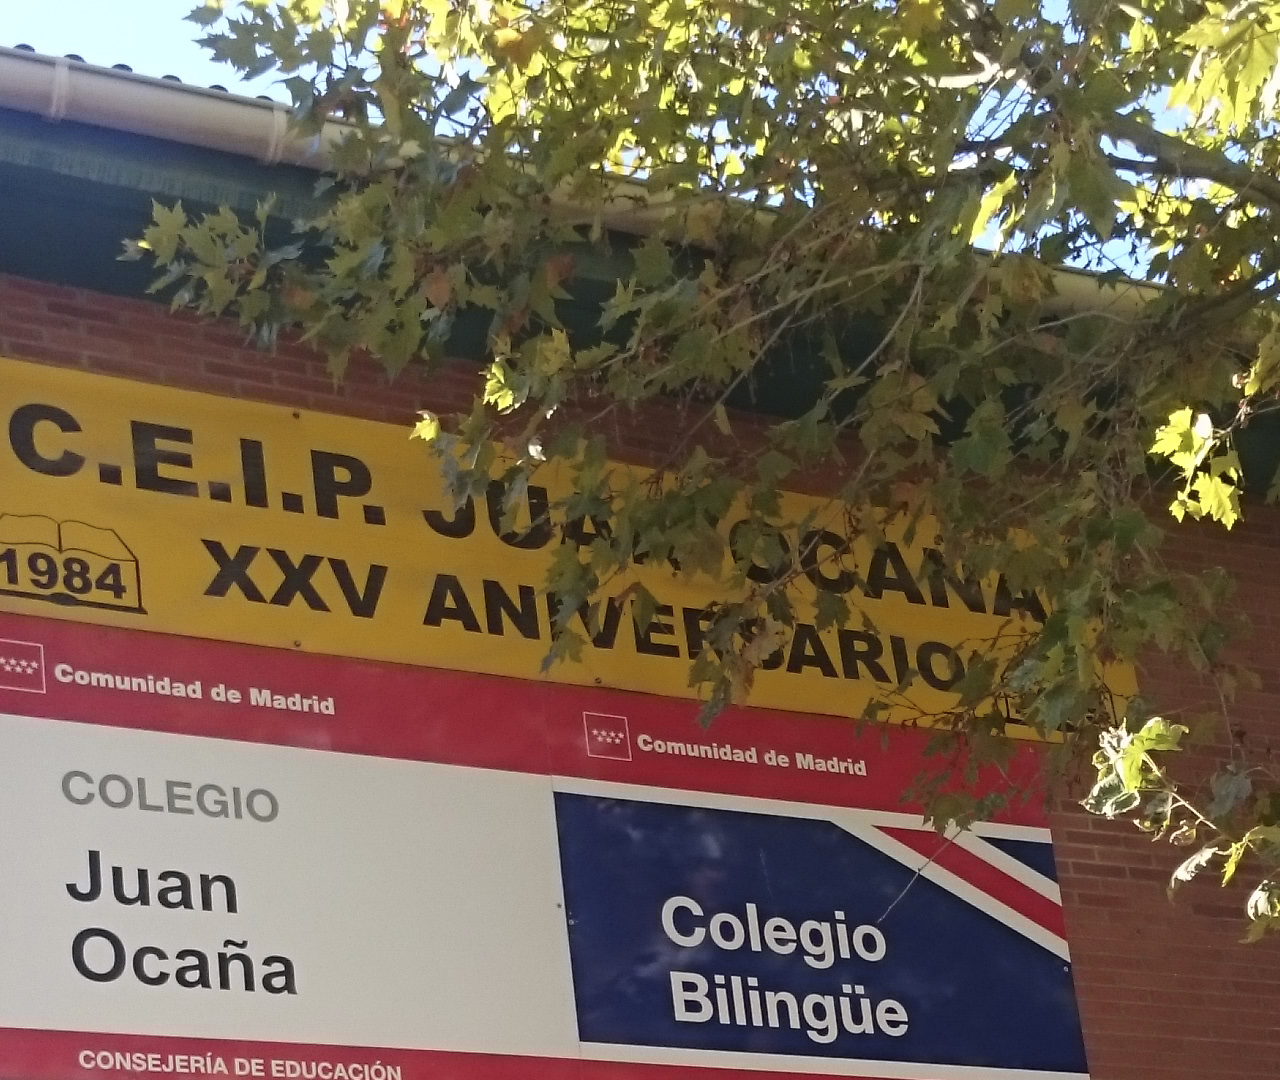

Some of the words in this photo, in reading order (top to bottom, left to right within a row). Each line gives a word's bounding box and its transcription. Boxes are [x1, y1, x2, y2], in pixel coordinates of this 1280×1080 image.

[7, 403, 386, 526] C.E.I.P.
[201, 538, 388, 619] XXV
[54, 663, 202, 699] Comunidad
[210, 681, 242, 704] de
[249, 687, 336, 716] Madrid
[637, 734, 758, 765] Comunidad
[763, 748, 790, 768] de
[795, 752, 867, 777] Madrid
[61, 770, 280, 823] COLEGIO
[65, 849, 238, 914] Juan
[71, 928, 298, 995] Ocaña
[661, 896, 887, 970] Colegio
[669, 970, 910, 1044] Bilingüe
[78, 1048, 228, 1075] CONSEJERÍA
[234, 1056, 265, 1077] DE
